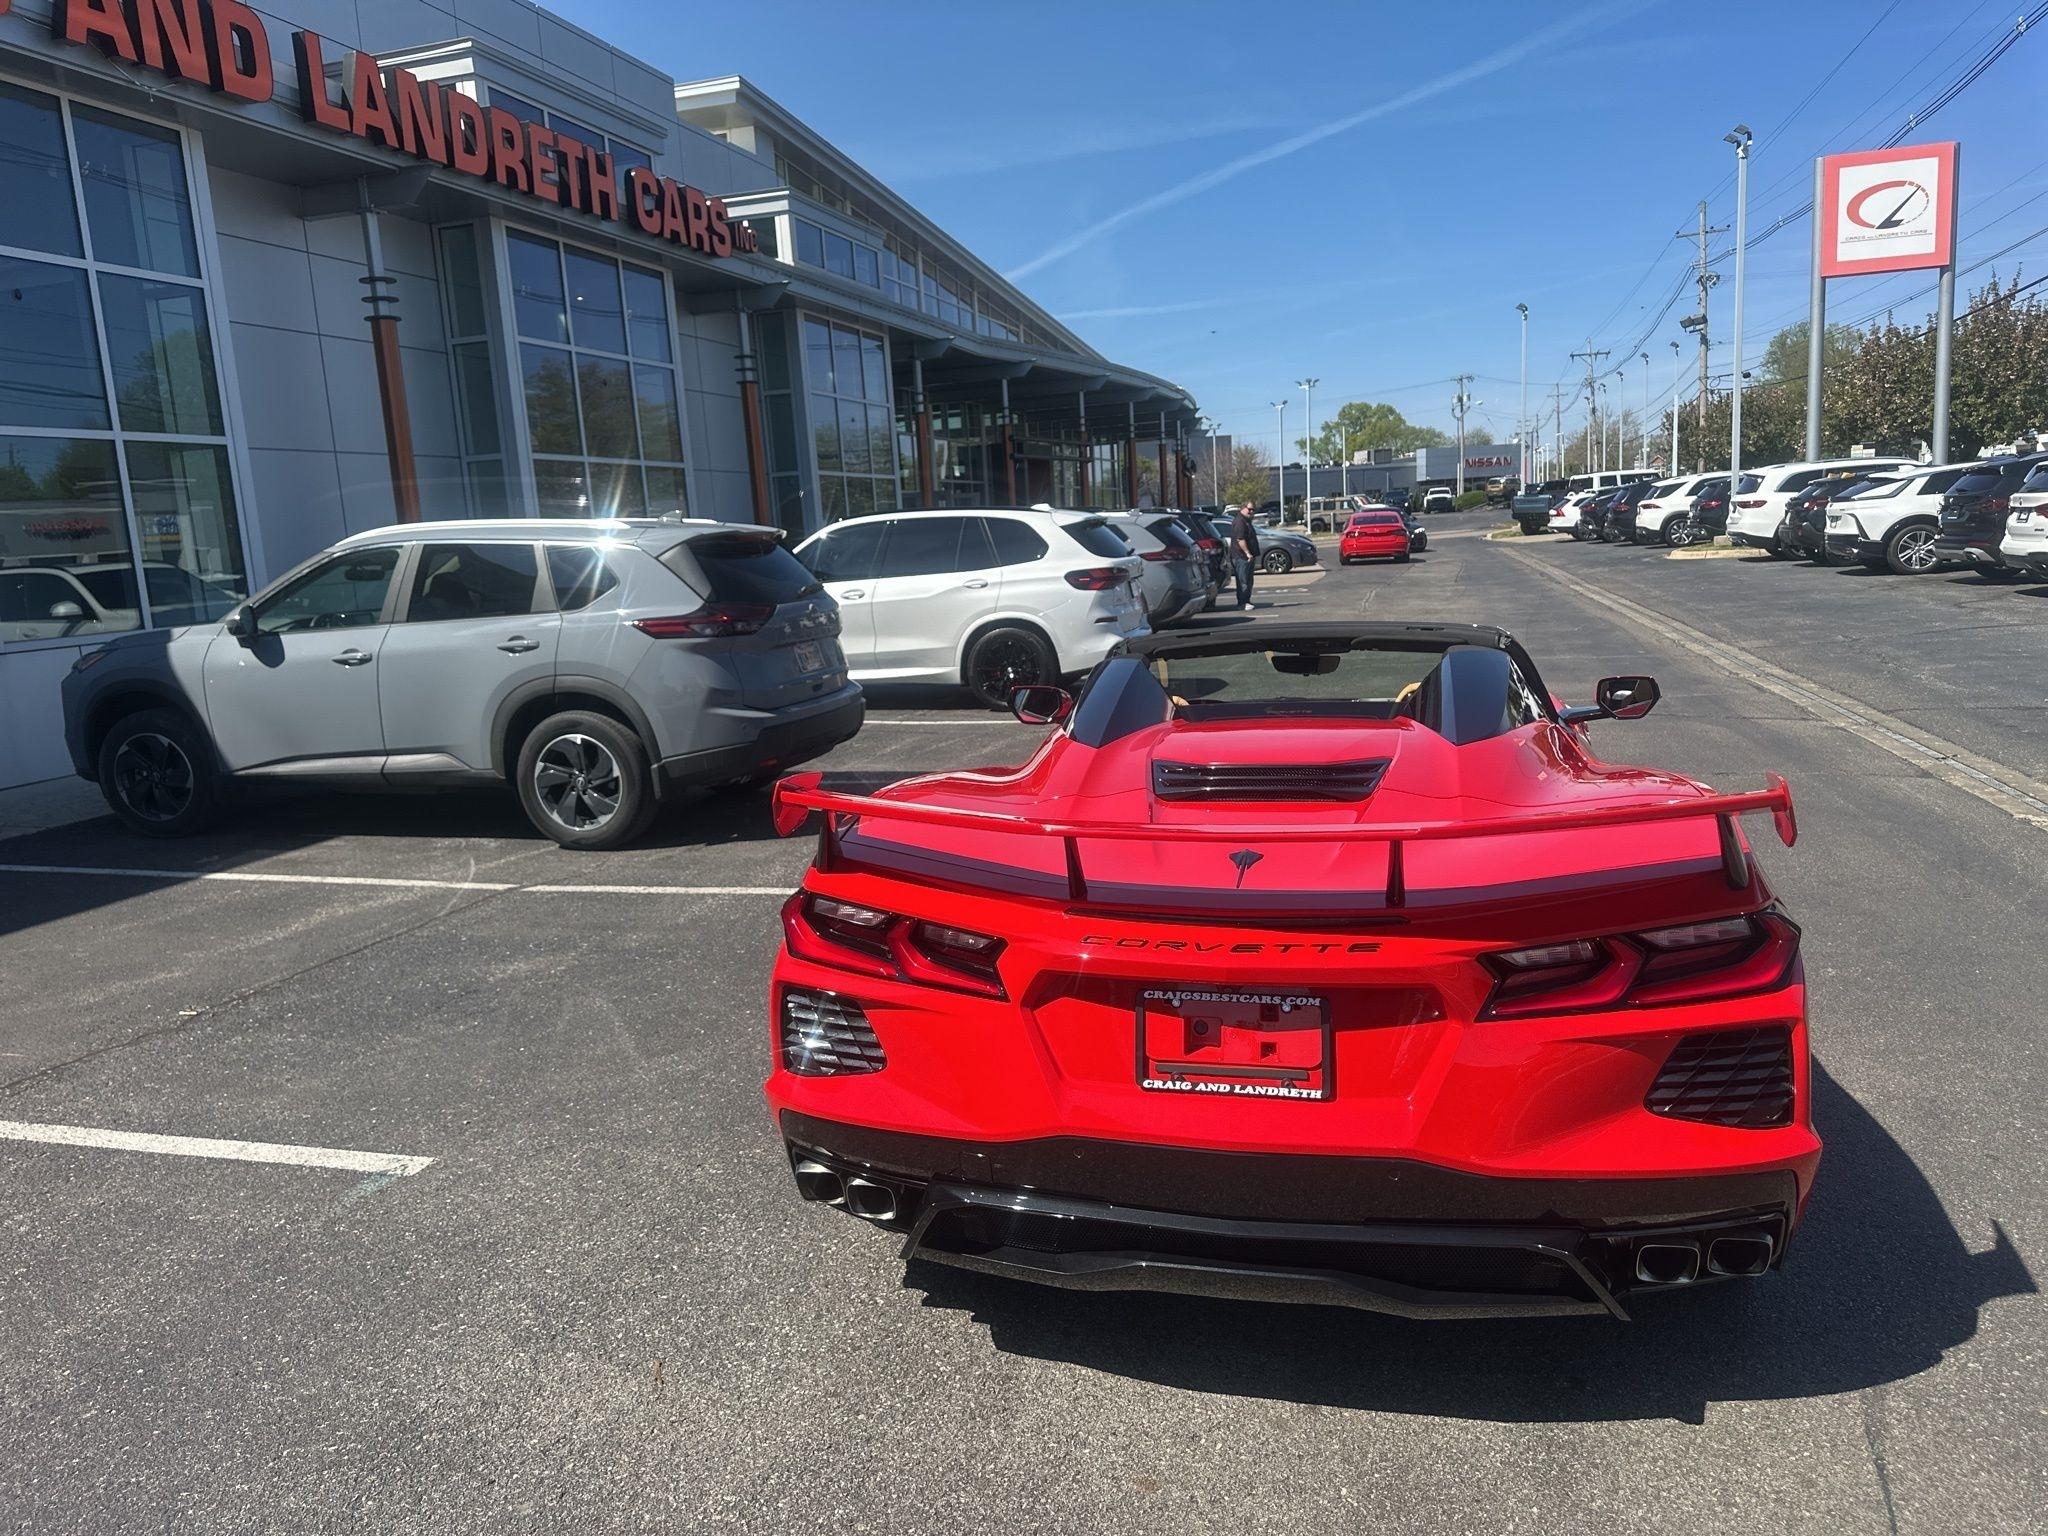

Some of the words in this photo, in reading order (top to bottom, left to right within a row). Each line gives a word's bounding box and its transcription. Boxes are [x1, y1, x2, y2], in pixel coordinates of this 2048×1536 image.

[300, 30, 619, 221] LANDRETH
[628, 166, 732, 258] CARS
[734, 220, 759, 253] INC
[1464, 456, 1512, 468] NISSAN
[1080, 935, 1383, 954] CORVETTE
[1143, 990, 1321, 1007] CRAIGSBESTCARS.COM
[1142, 1079, 1193, 1091] CRAIG
[1195, 1082, 1231, 1094] AND
[1233, 1084, 1323, 1100] LANDRETH
